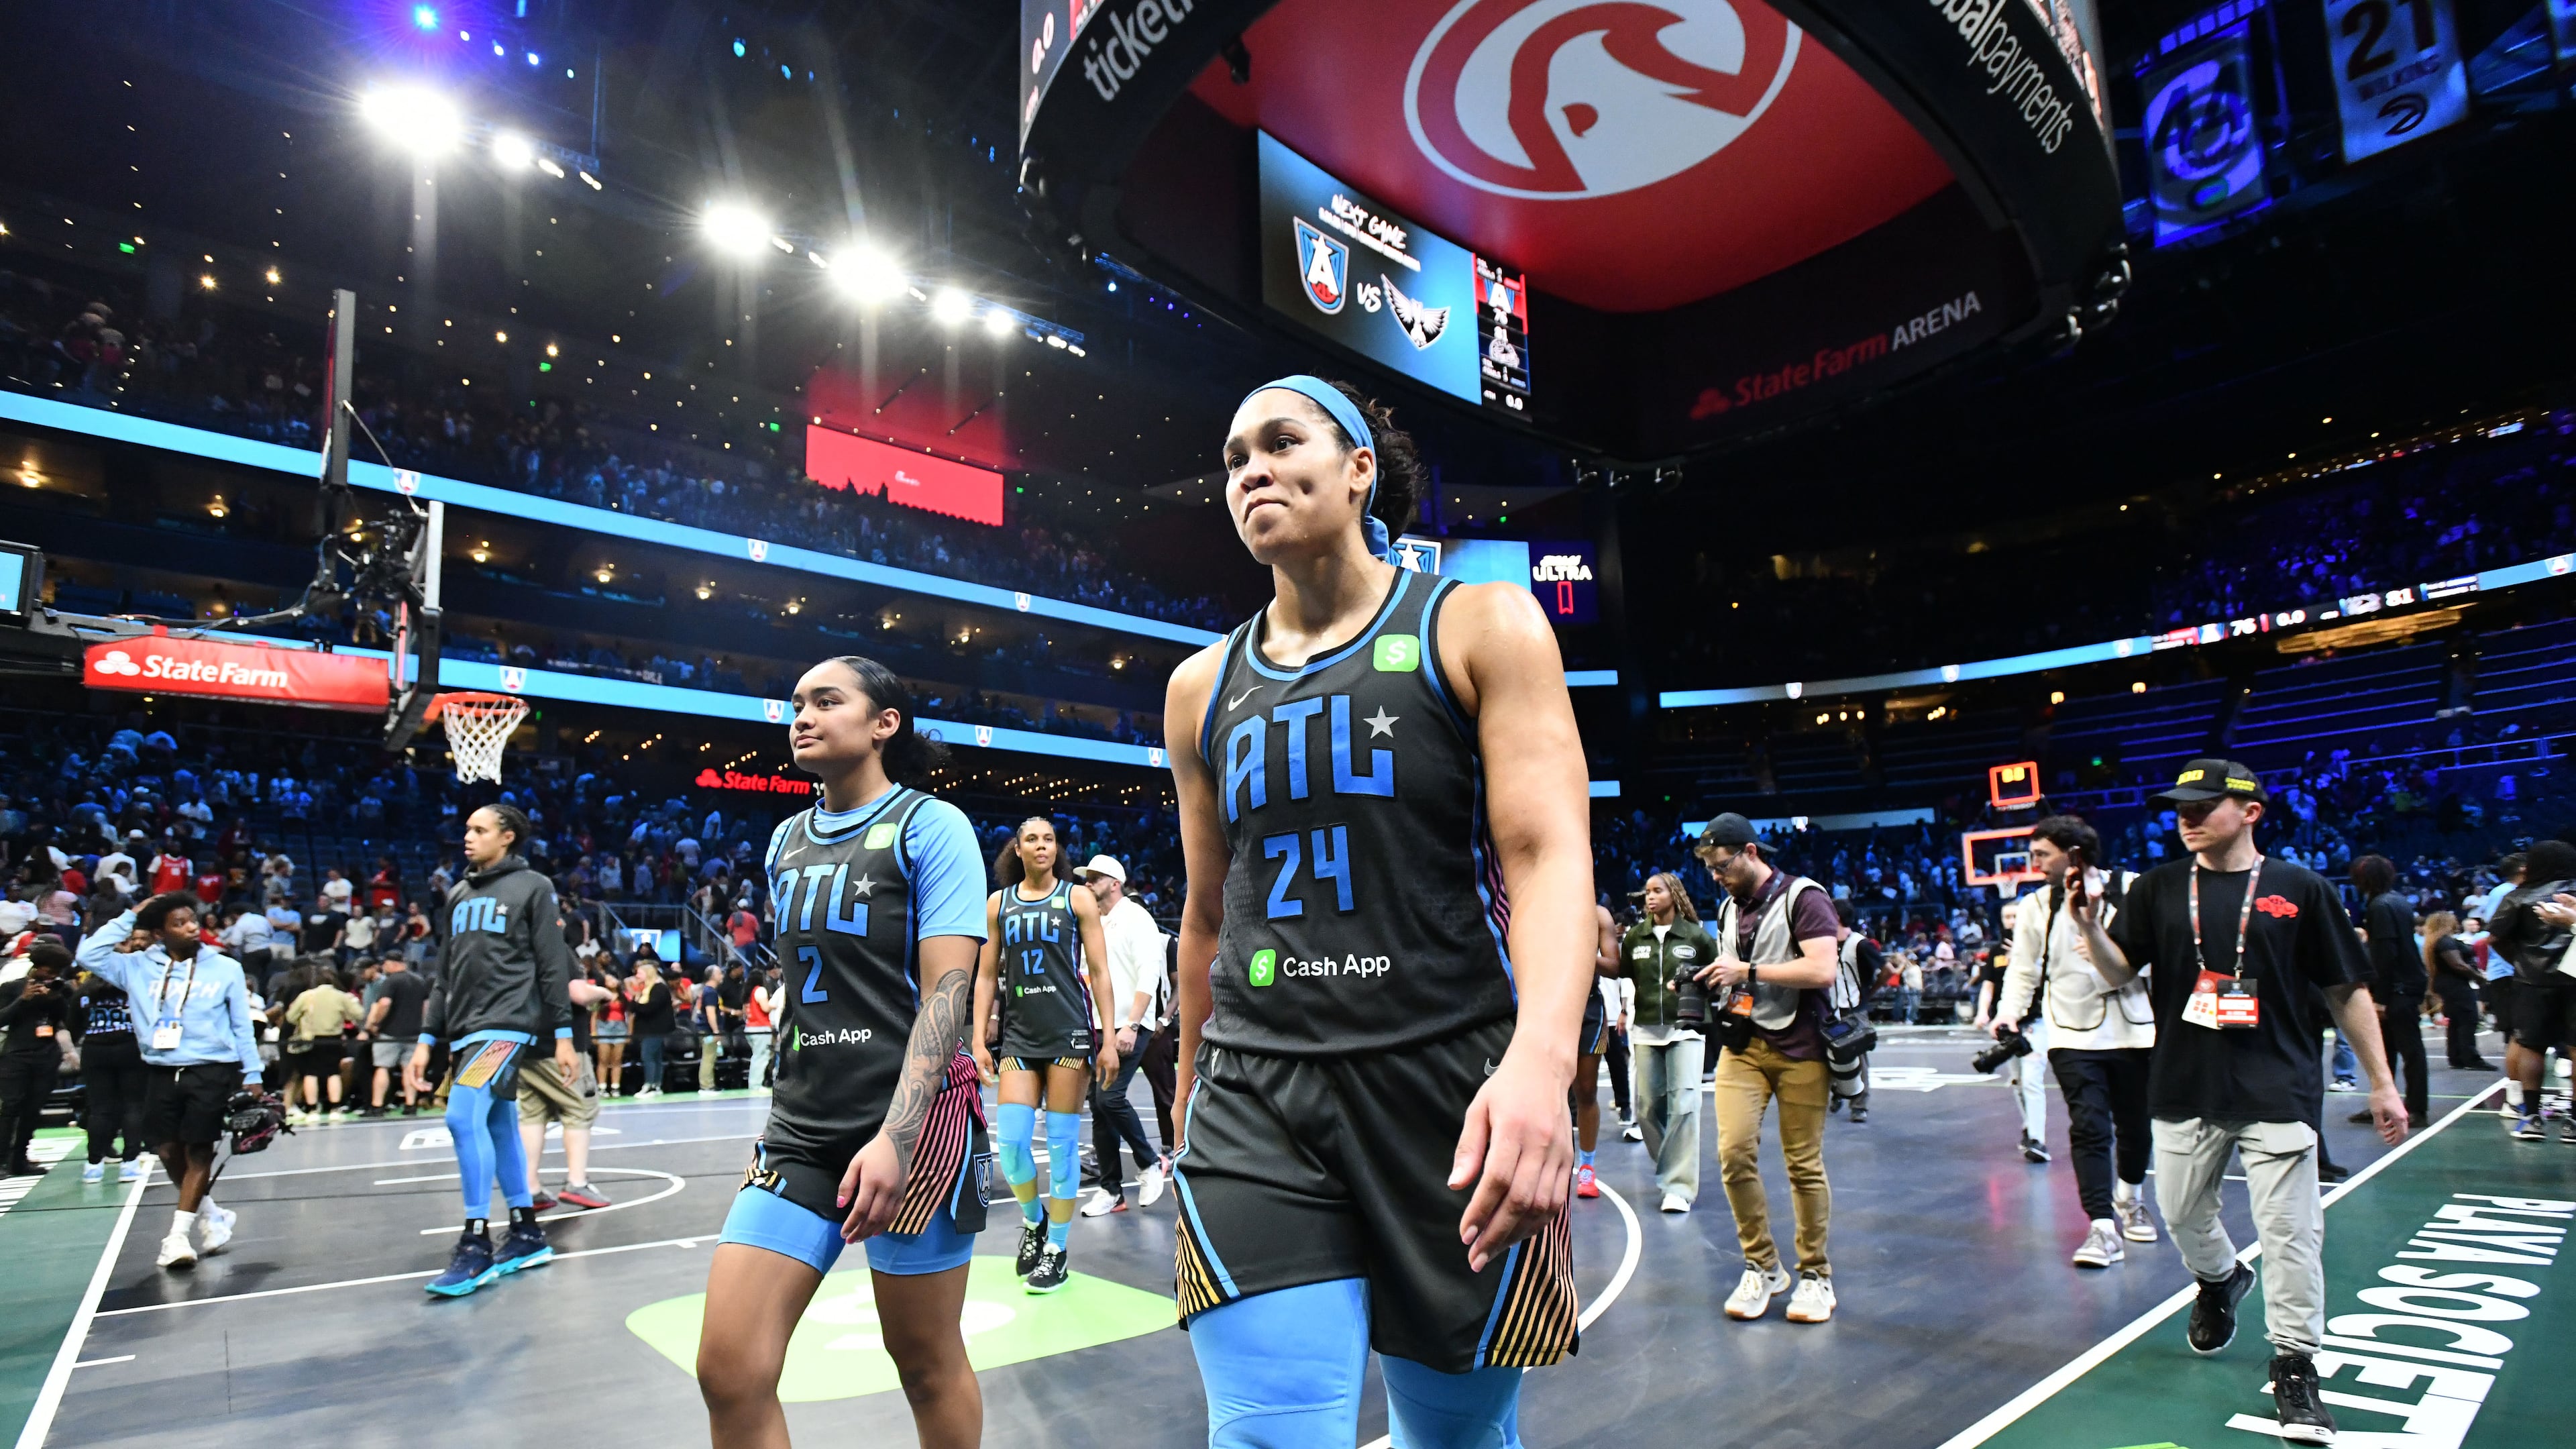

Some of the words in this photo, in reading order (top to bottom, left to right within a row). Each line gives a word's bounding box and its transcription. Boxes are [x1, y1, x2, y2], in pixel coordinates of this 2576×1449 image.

[1083, 0, 1193, 101] ticket
[2341, 0, 2437, 80] 21
[1929, 0, 2074, 154] balpayments
[1331, 193, 1368, 227] NEXT
[1368, 215, 1407, 250] GAME
[1357, 282, 1382, 313] VS
[1734, 363, 1811, 407] State
[1813, 333, 1888, 382] Farm
[1892, 290, 1982, 351] ARENA
[1505, 394, 1523, 411] 0.0
[1532, 564, 1593, 582] ULTRA
[2385, 587, 2415, 607] 81
[2230, 617, 2257, 637] 76
[2276, 609, 2306, 627] 0.0
[142, 654, 219, 682] State
[219, 661, 288, 688] Farm
[1226, 694, 1395, 824] ATL
[722, 771, 768, 792] State
[769, 775, 811, 795] Farm
[1264, 825, 1354, 920] 24
[451, 896, 506, 937] ATL
[774, 863, 869, 941] ATL
[1004, 911, 1059, 947] ATL
[797, 945, 828, 1004] 2
[1020, 949, 1045, 976] 12
[1283, 957, 1337, 977] Cash
[1342, 952, 1391, 977] App
[1024, 987, 1042, 995] Cash
[1042, 985, 1057, 994] App
[800, 1030, 836, 1046] Cash
[838, 1028, 872, 1044] App
[2394, 1193, 2576, 1265] PLAYA
